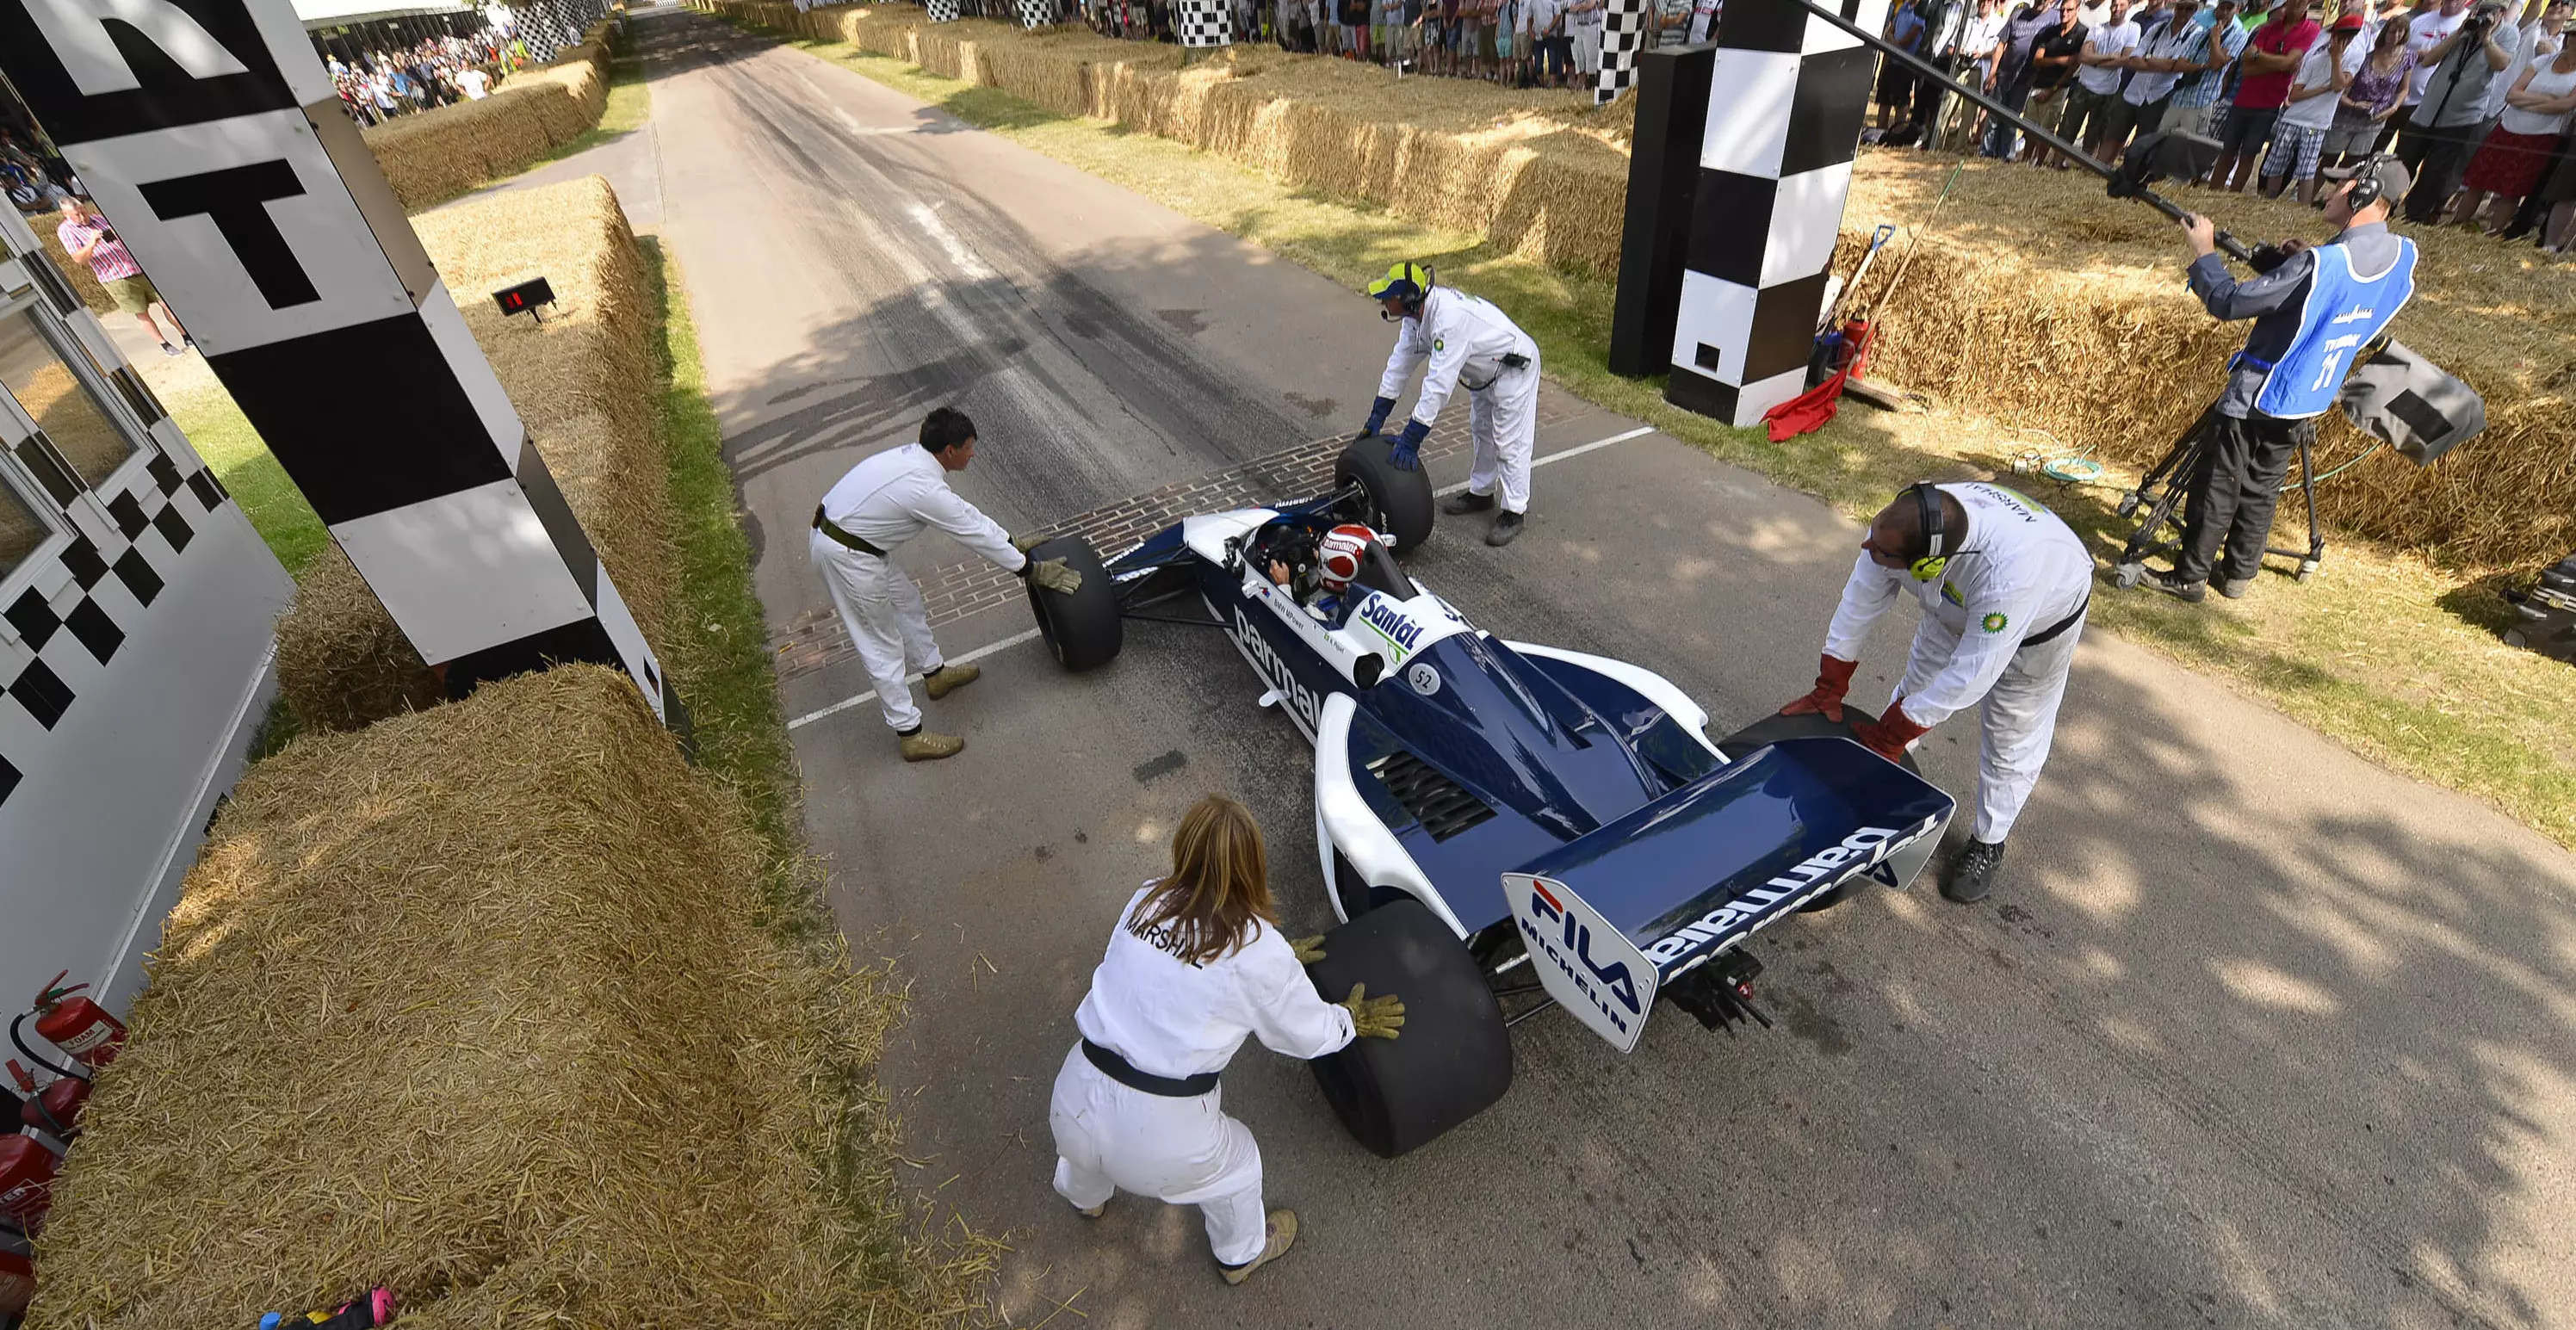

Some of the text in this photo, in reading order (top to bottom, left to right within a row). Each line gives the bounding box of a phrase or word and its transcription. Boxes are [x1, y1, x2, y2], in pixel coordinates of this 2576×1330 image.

[1415, 670, 1433, 689] 52
[1123, 915, 1204, 971] MARSHL
[1531, 879, 1641, 1015] FILA
[1520, 916, 1627, 1036] MICHELIN
[69, 1029, 96, 1046] FOAM
